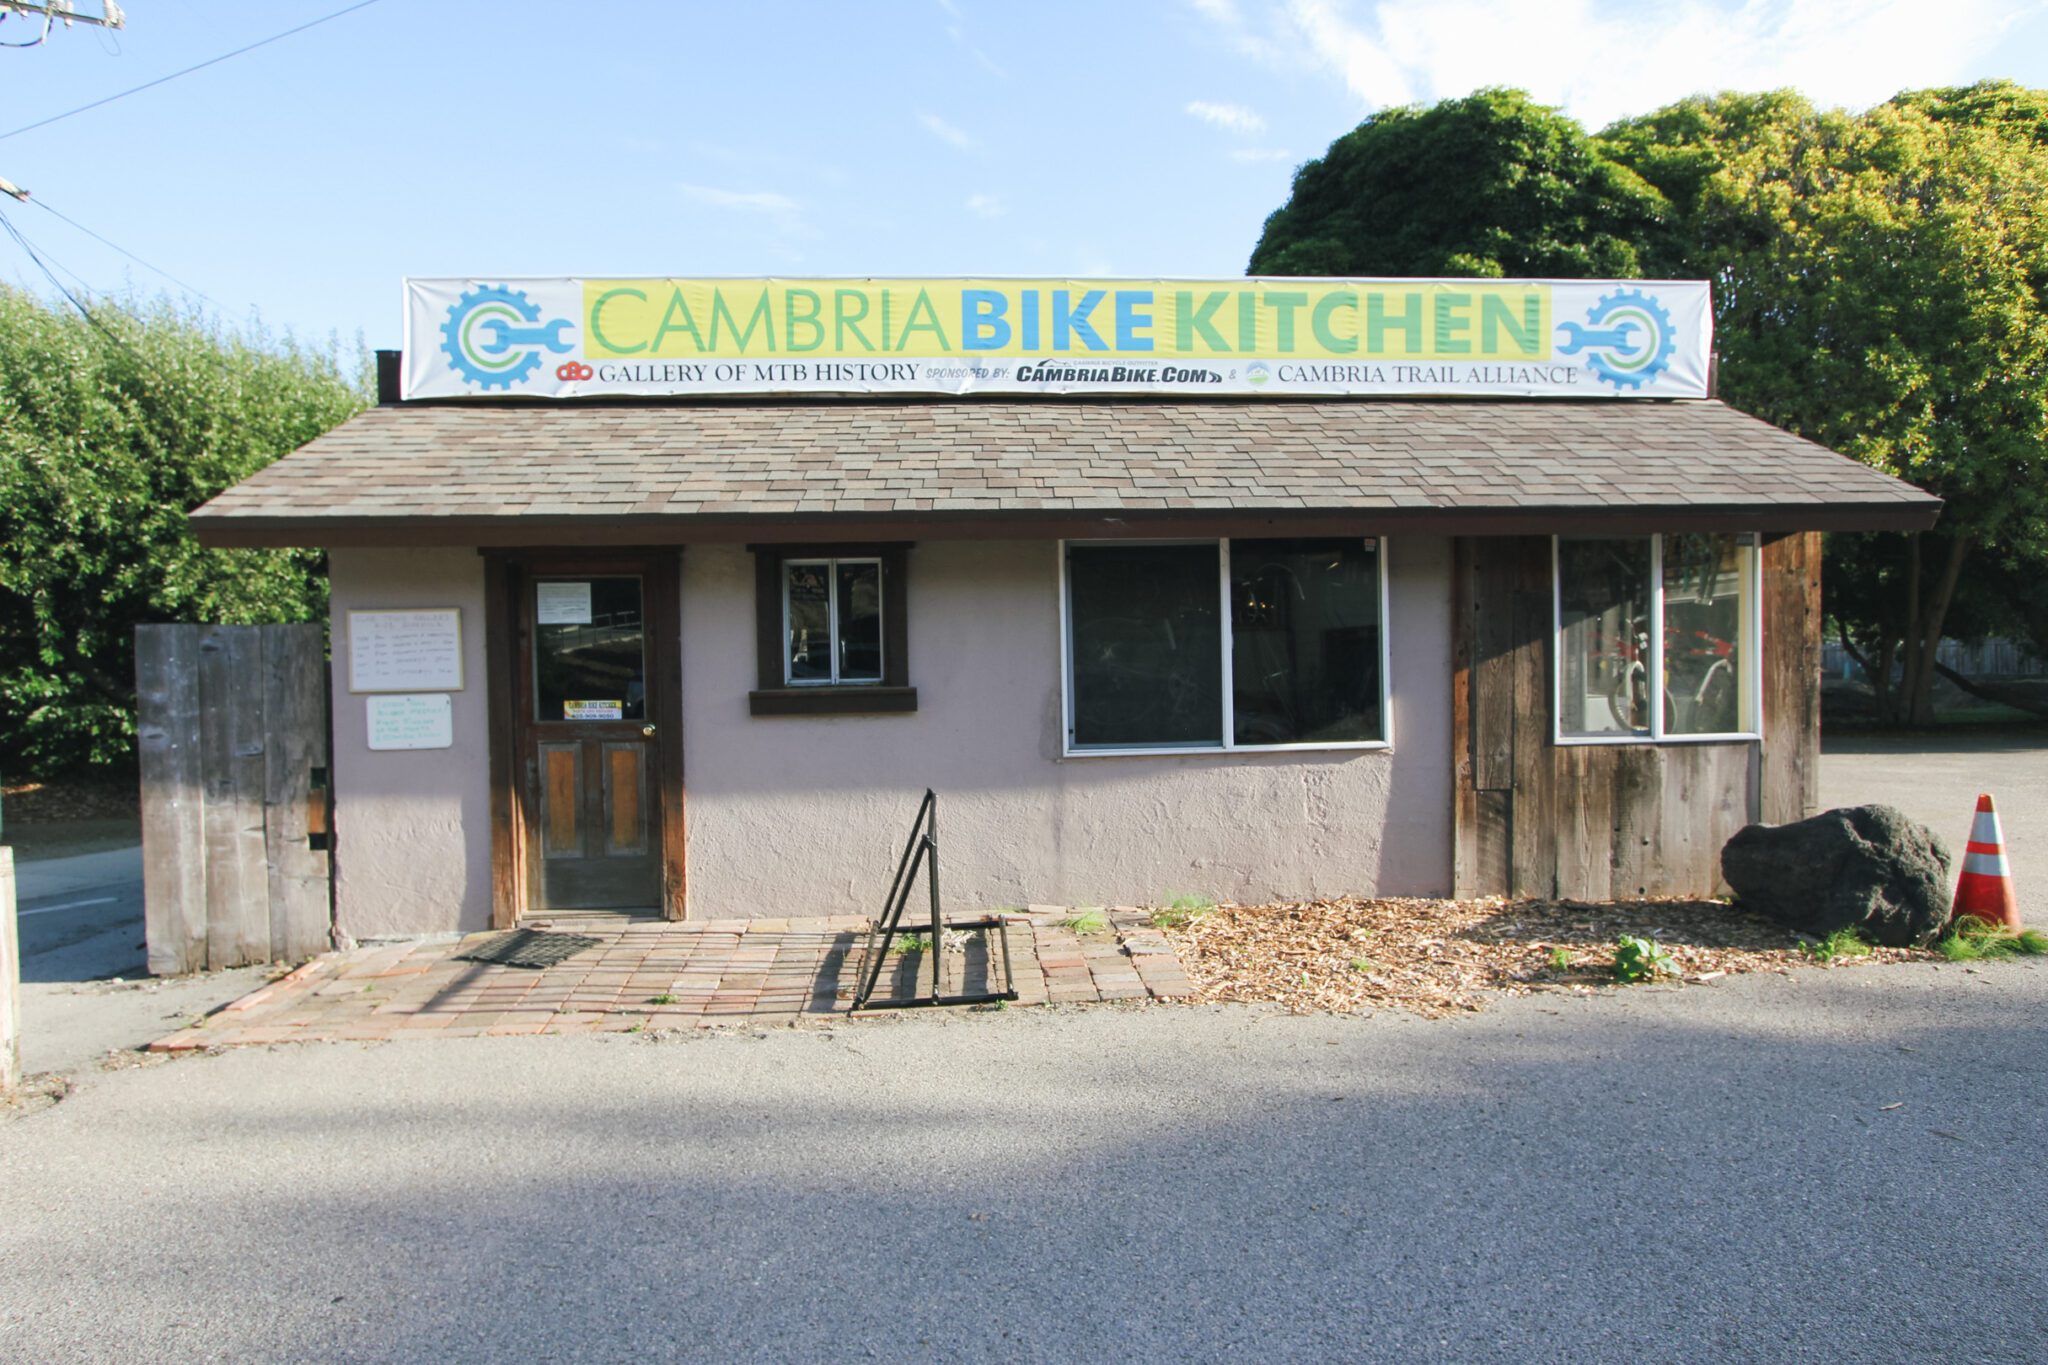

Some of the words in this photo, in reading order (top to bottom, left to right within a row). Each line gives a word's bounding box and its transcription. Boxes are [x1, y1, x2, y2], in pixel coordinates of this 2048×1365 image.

[590, 286, 953, 355] CAMBRIA
[961, 289, 1155, 351] BIKE
[1174, 289, 1541, 355] KITCHEN
[599, 364, 708, 383] GALLERY
[715, 363, 748, 382] OF
[755, 363, 808, 382] MTB
[815, 362, 921, 382] HISTORY
[926, 367, 989, 380] SPONSORED
[992, 368, 1010, 380] BY:
[1278, 365, 1386, 383] CAMBRIA
[1392, 365, 1461, 384] TRAIL
[1466, 366, 1579, 385] ALLIANCE
